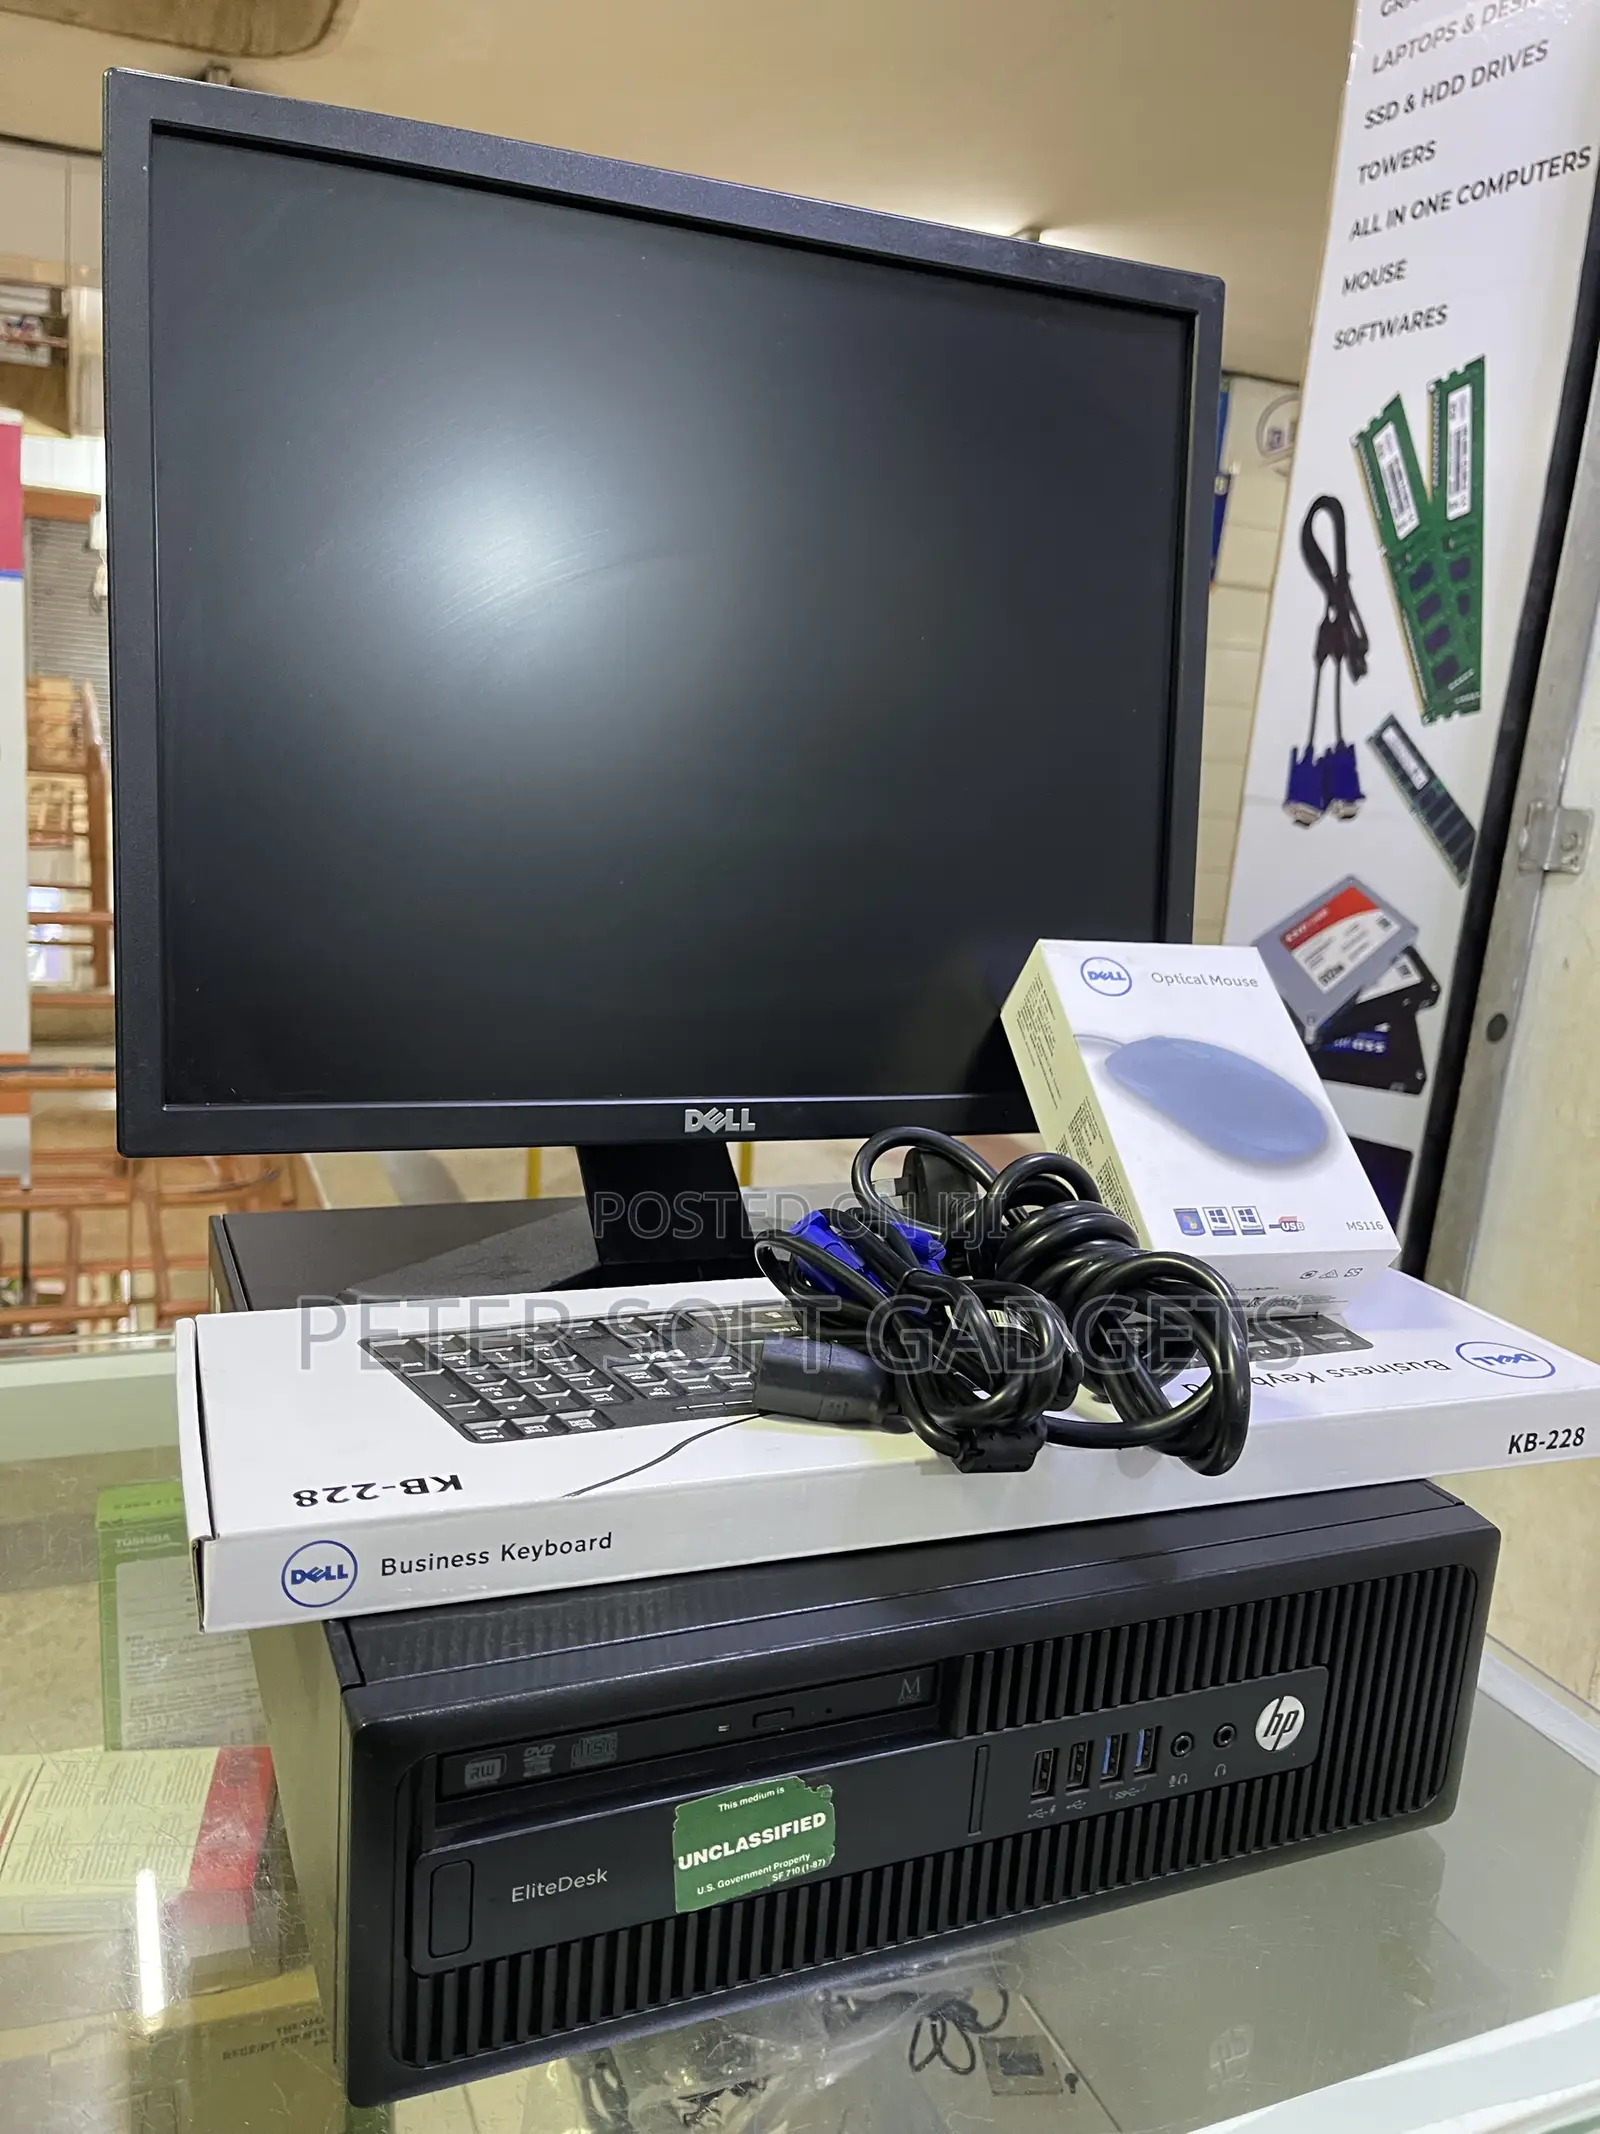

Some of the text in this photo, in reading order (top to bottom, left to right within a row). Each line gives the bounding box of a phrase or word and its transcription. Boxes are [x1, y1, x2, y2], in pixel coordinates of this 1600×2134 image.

[1372, 20, 1458, 75] LAPTOPS
[1462, 13, 1475, 34] &
[1364, 39, 1549, 129] SSD & HDD DRIVES
[1357, 140, 1437, 185] TOWERS
[1349, 145, 1591, 241] ALL IN ONE COMPUTERS
[1341, 258, 1408, 296] MOUSE
[1333, 304, 1448, 350] SOFTWARES
[1151, 972, 1207, 987] Optical
[1209, 974, 1259, 988] Mouse
[684, 1106, 756, 1134] DELL
[1281, 1221, 1305, 1232] USB
[1345, 1221, 1384, 1232] MS116
[1326, 1359, 1452, 1378] Business
[1507, 1427, 1585, 1455] KB-228
[292, 1474, 463, 1507] KB-228
[291, 1532, 613, 1586] DELL Business Keyboard
[1262, 1696, 1300, 1751] hp
[470, 1762, 496, 1780] RW
[718, 1786, 785, 1812] This medium is
[677, 1812, 826, 1870] UNCLASSIFIED
[512, 1867, 608, 1903] EliteDesk
[697, 1853, 811, 1895] U.S. Government Property
[771, 1858, 826, 1882] SF 710 (1-87)
